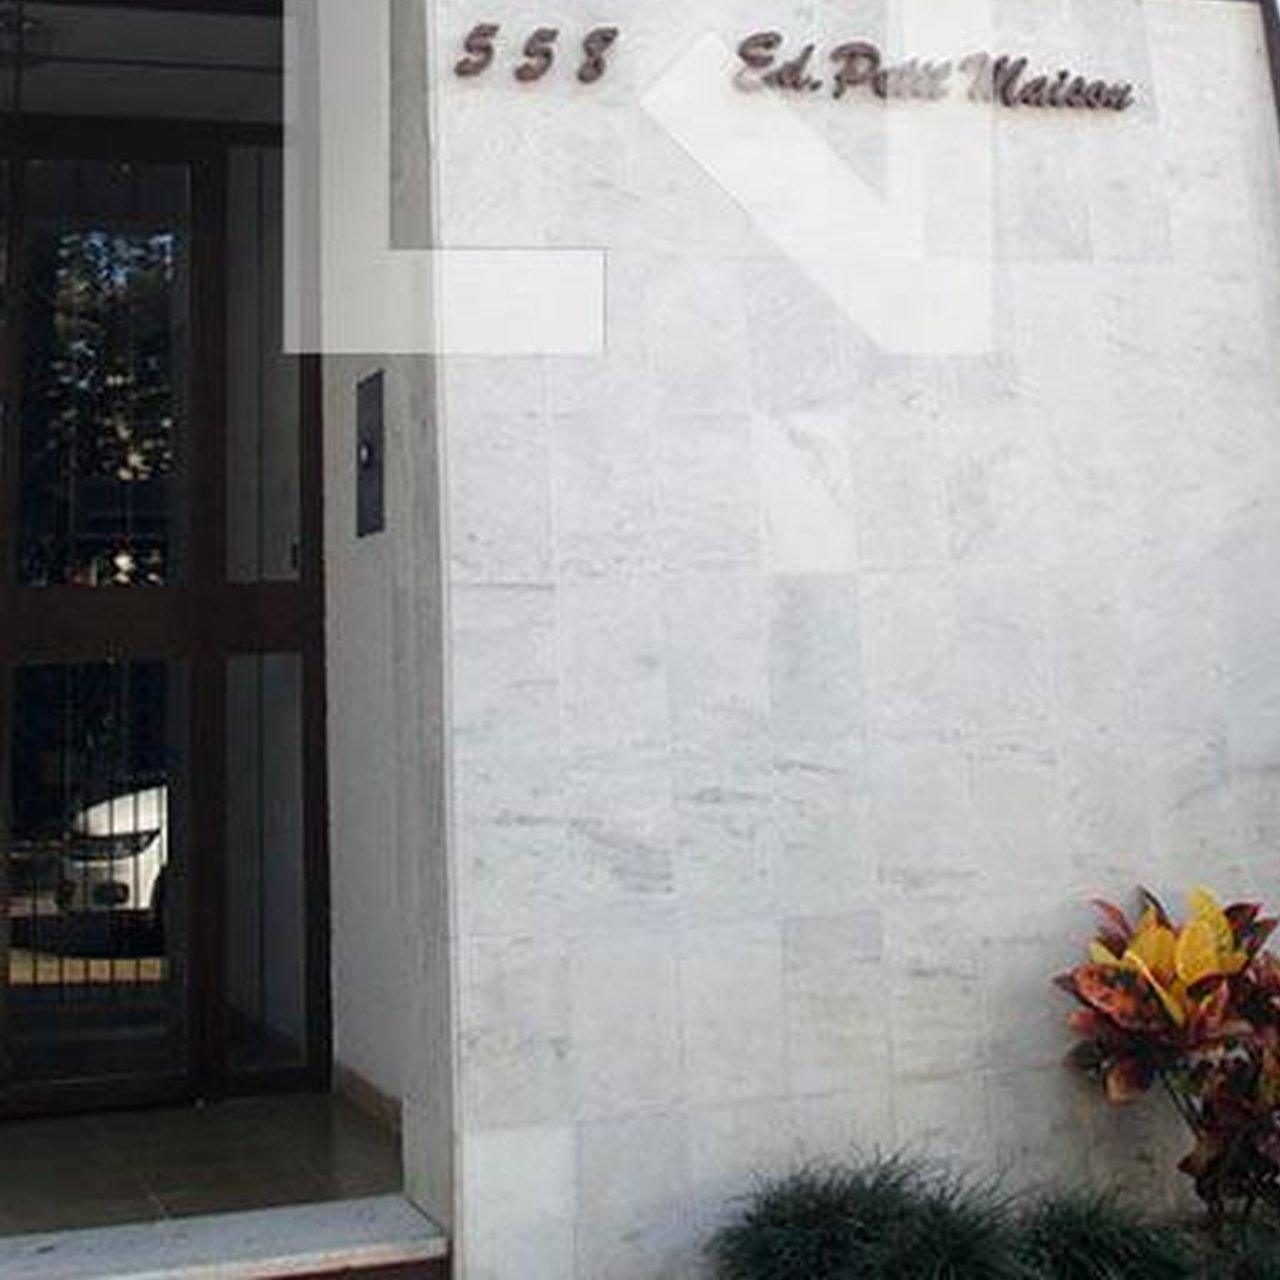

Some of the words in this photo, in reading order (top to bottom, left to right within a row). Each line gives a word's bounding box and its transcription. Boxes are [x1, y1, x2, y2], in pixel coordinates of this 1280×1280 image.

[453, 22, 619, 83] 558
[734, 31, 822, 92] Ed.
[958, 51, 1132, 110] Maison
